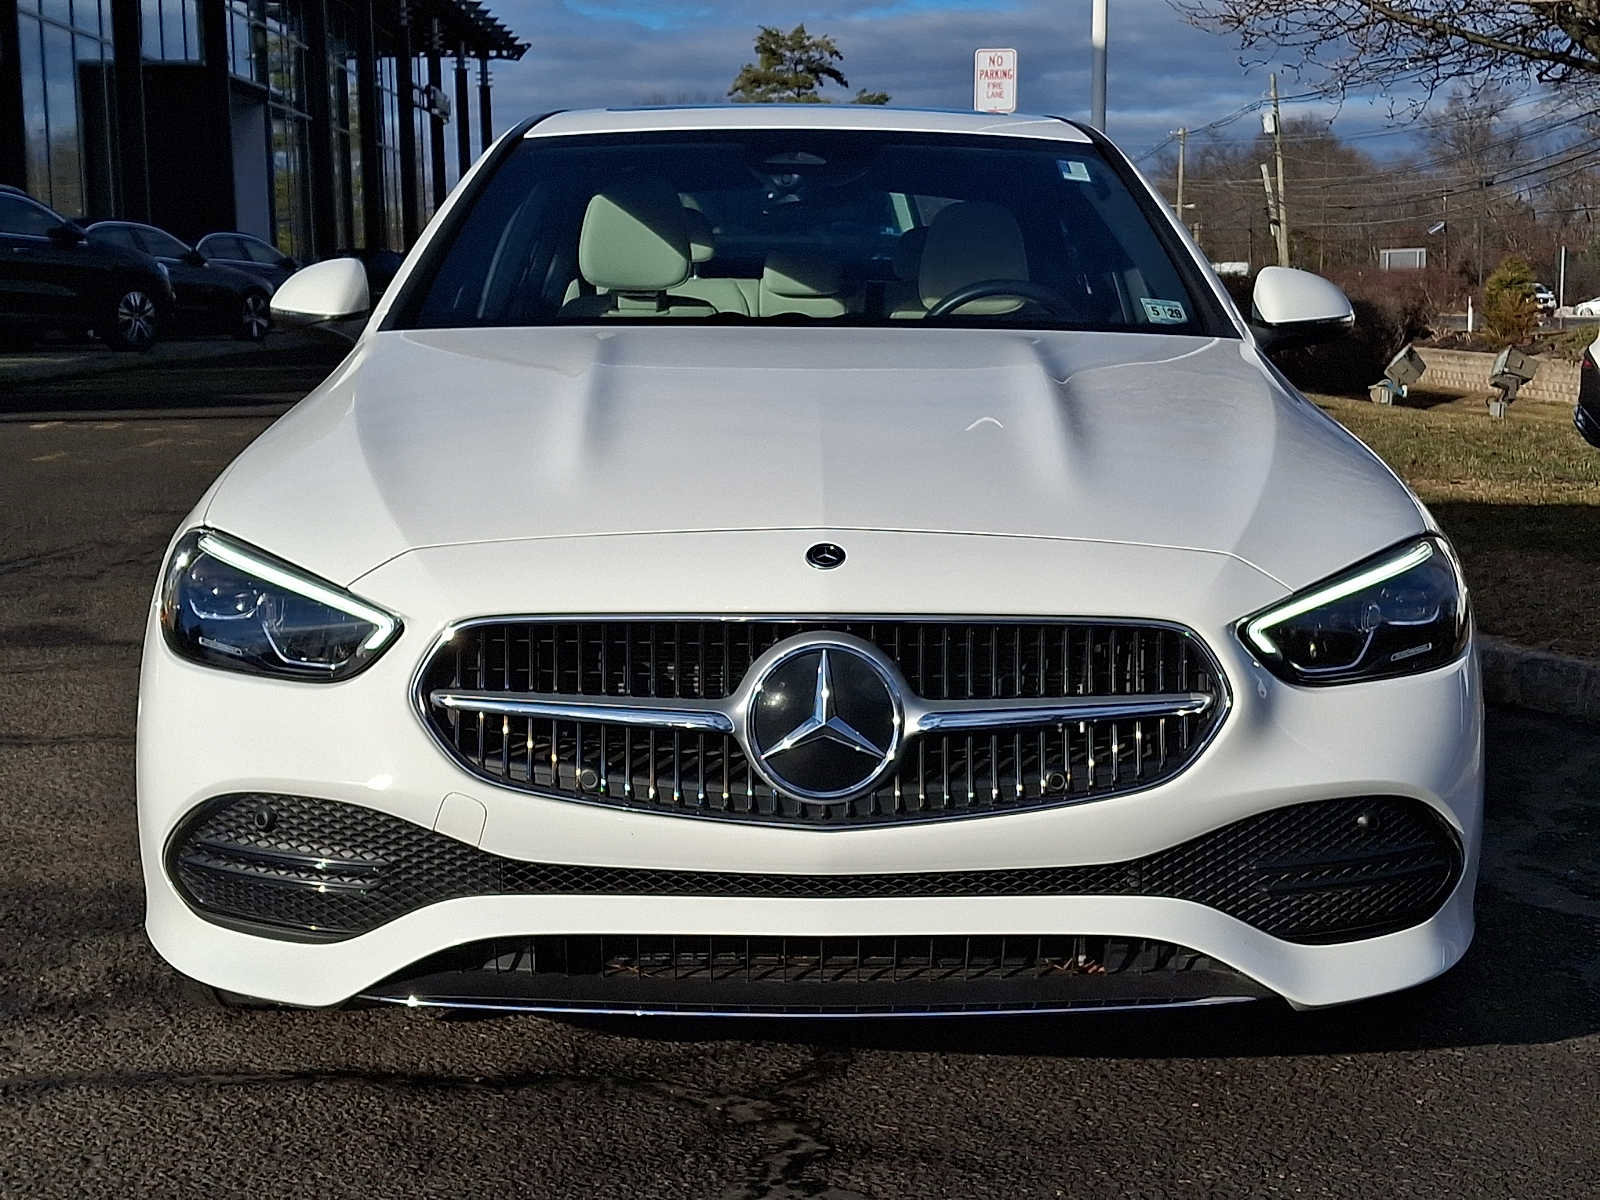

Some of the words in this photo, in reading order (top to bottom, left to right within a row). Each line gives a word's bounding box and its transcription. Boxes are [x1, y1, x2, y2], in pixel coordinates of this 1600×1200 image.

[989, 55, 1003, 67] NO
[979, 69, 1013, 80] PARKING
[986, 91, 1004, 99] LANE
[1151, 306, 1160, 316] 5
